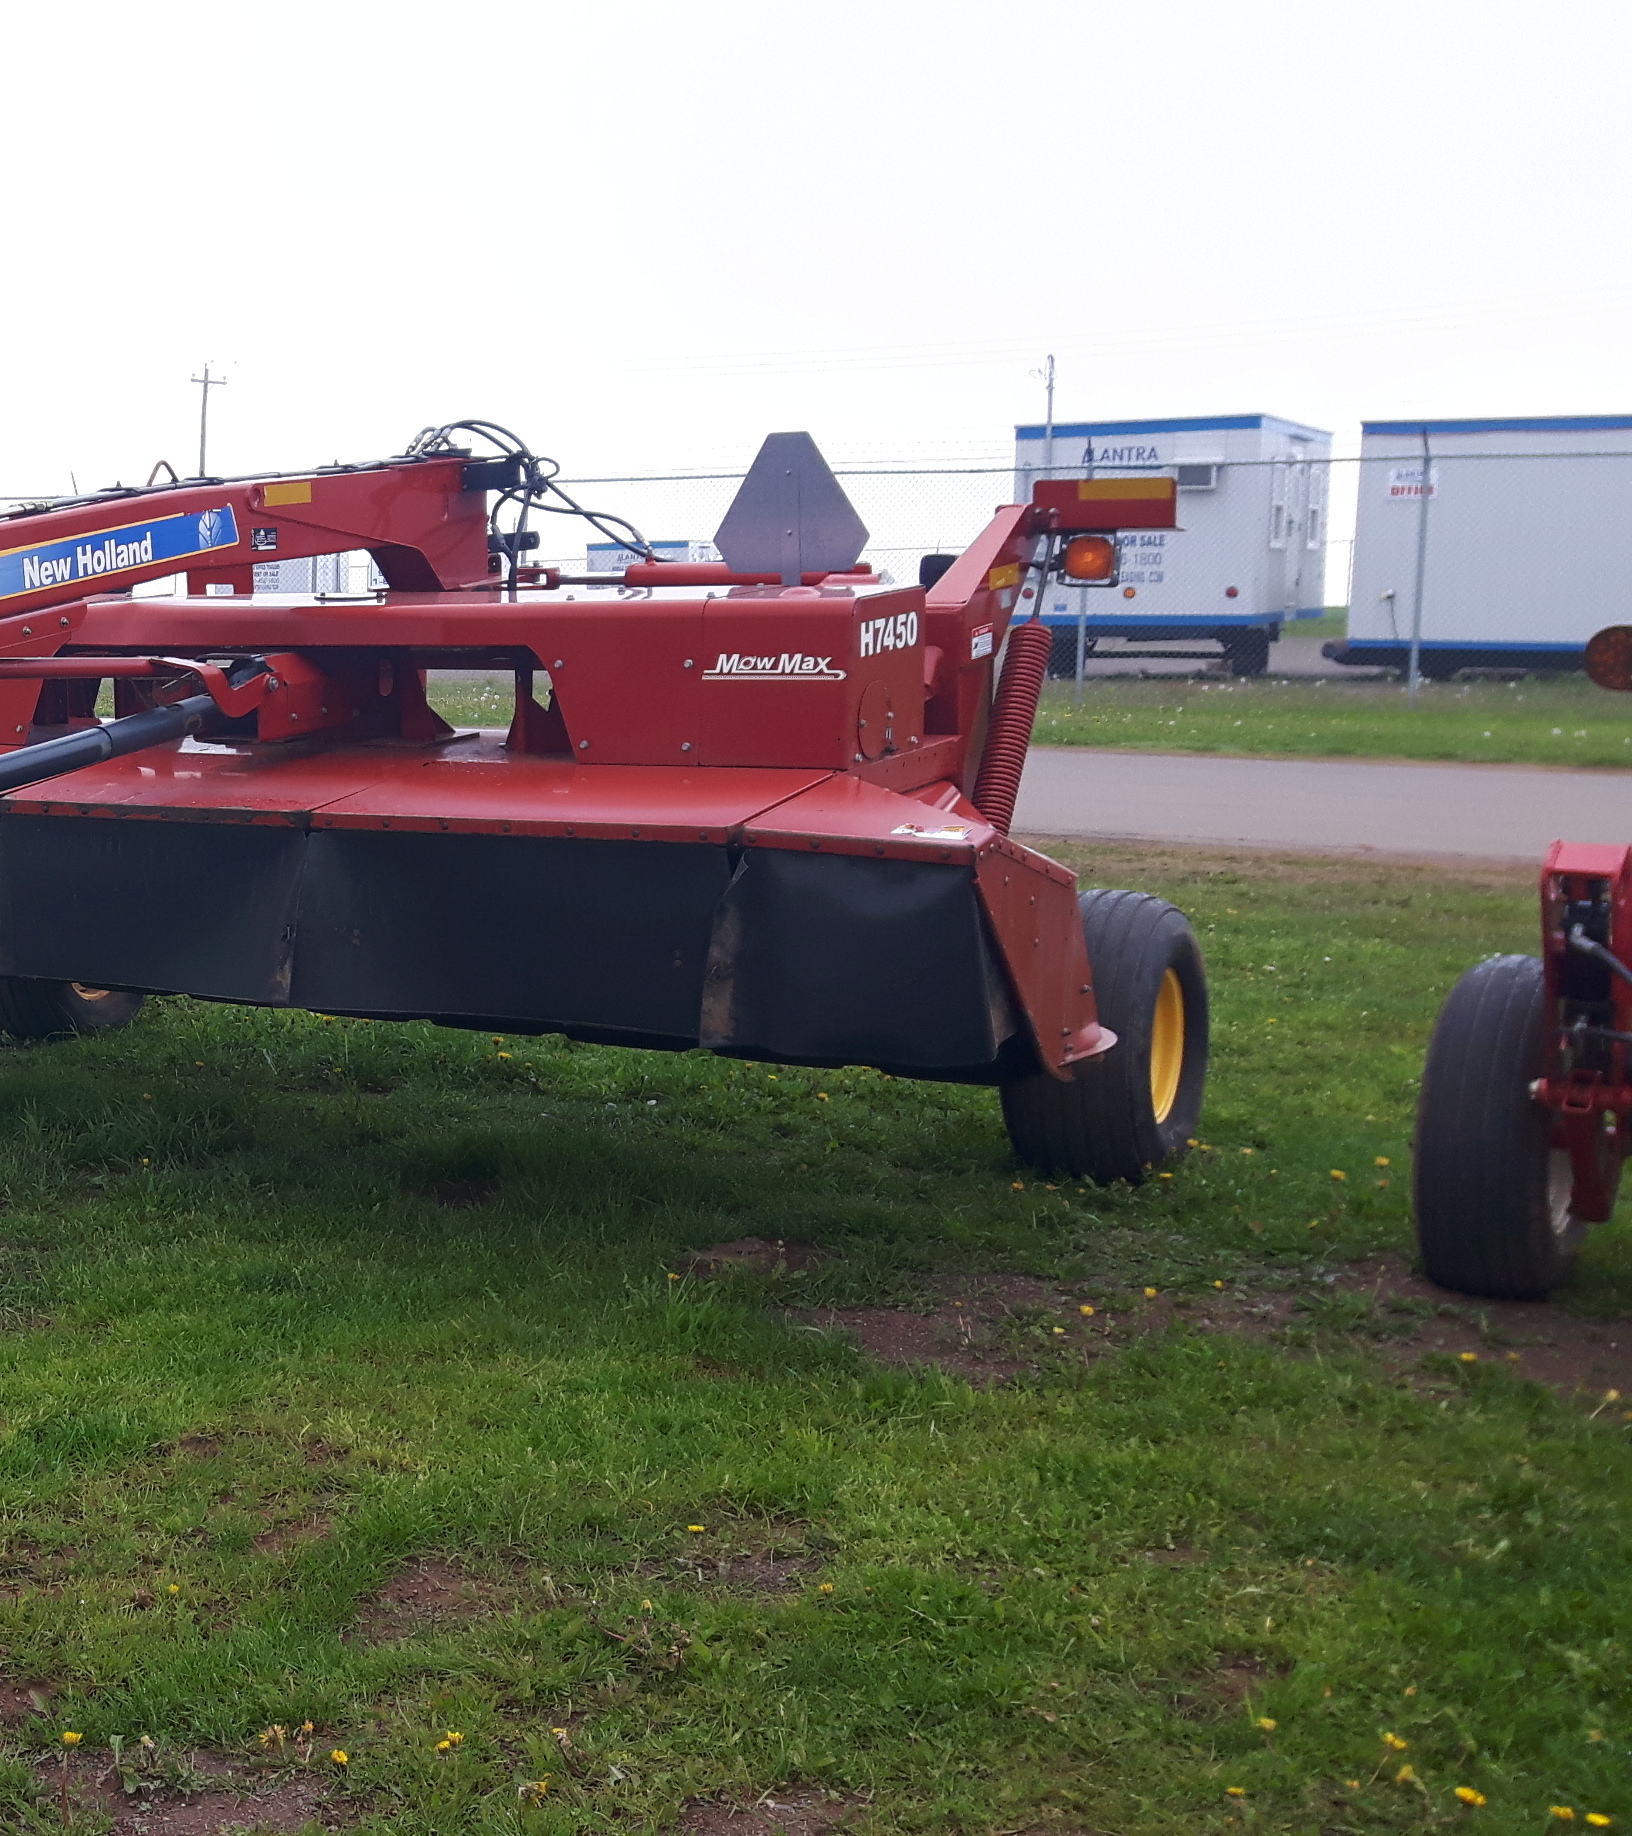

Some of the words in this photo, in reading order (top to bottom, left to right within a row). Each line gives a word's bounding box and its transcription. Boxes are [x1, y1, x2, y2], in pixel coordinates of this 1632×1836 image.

[22, 555, 72, 589] New
[76, 531, 153, 577] Holland
[1140, 534, 1165, 546] SALE
[860, 611, 918, 658] H7450
